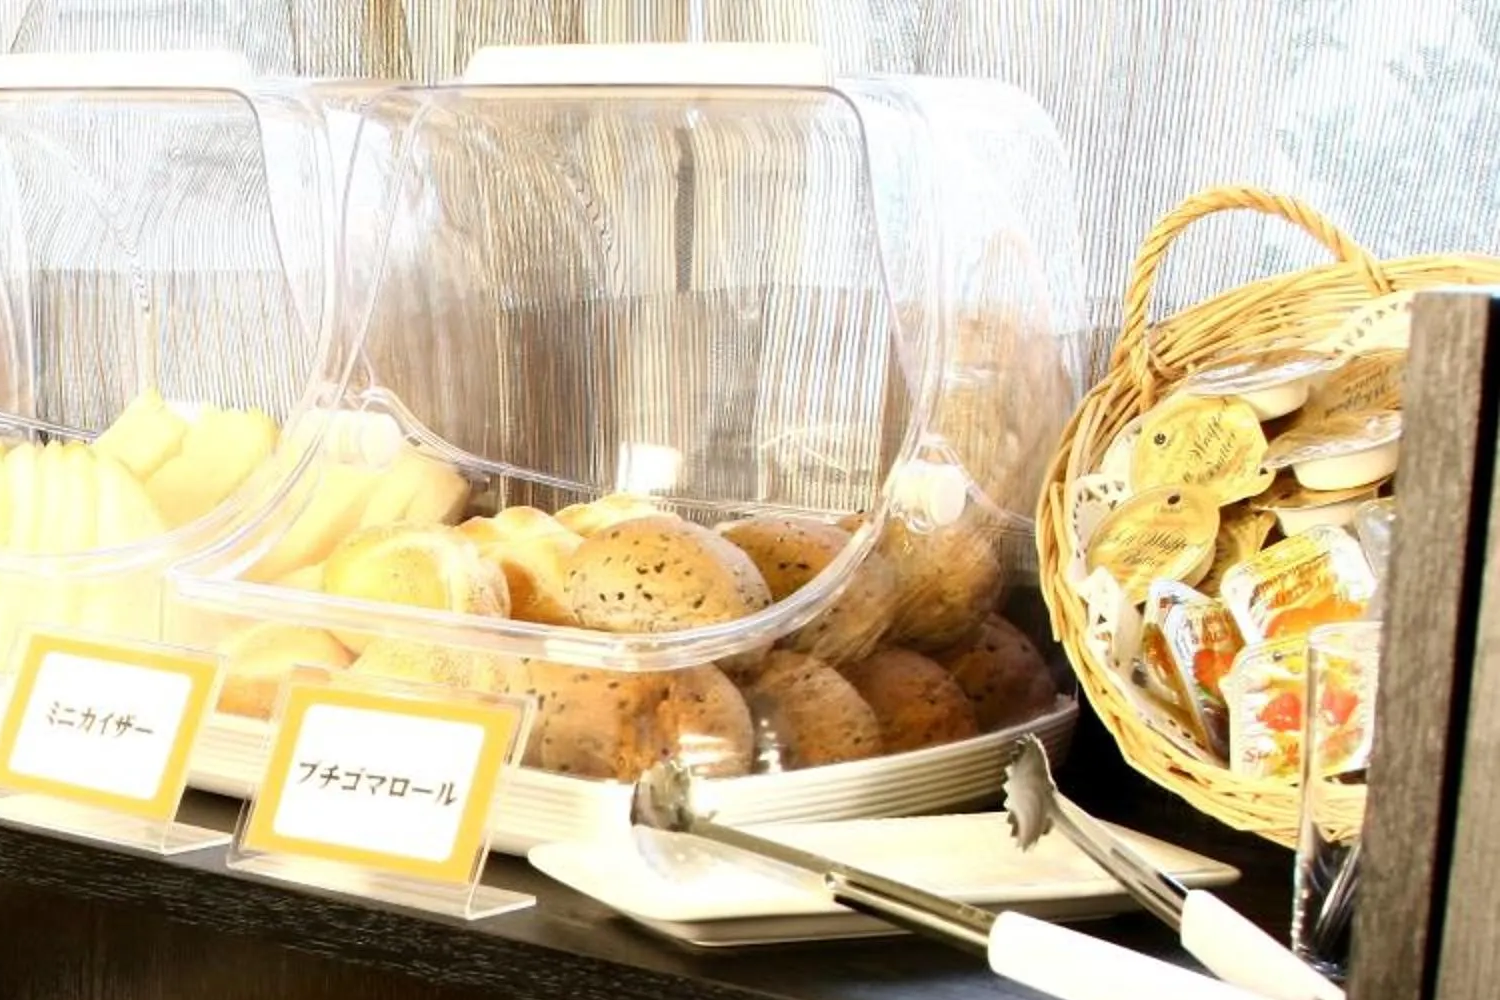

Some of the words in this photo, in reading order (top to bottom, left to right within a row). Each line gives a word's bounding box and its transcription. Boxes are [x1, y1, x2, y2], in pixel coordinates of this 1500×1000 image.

[47, 701, 154, 738] ミニカイザー
[298, 759, 457, 805] プチゴマロール
